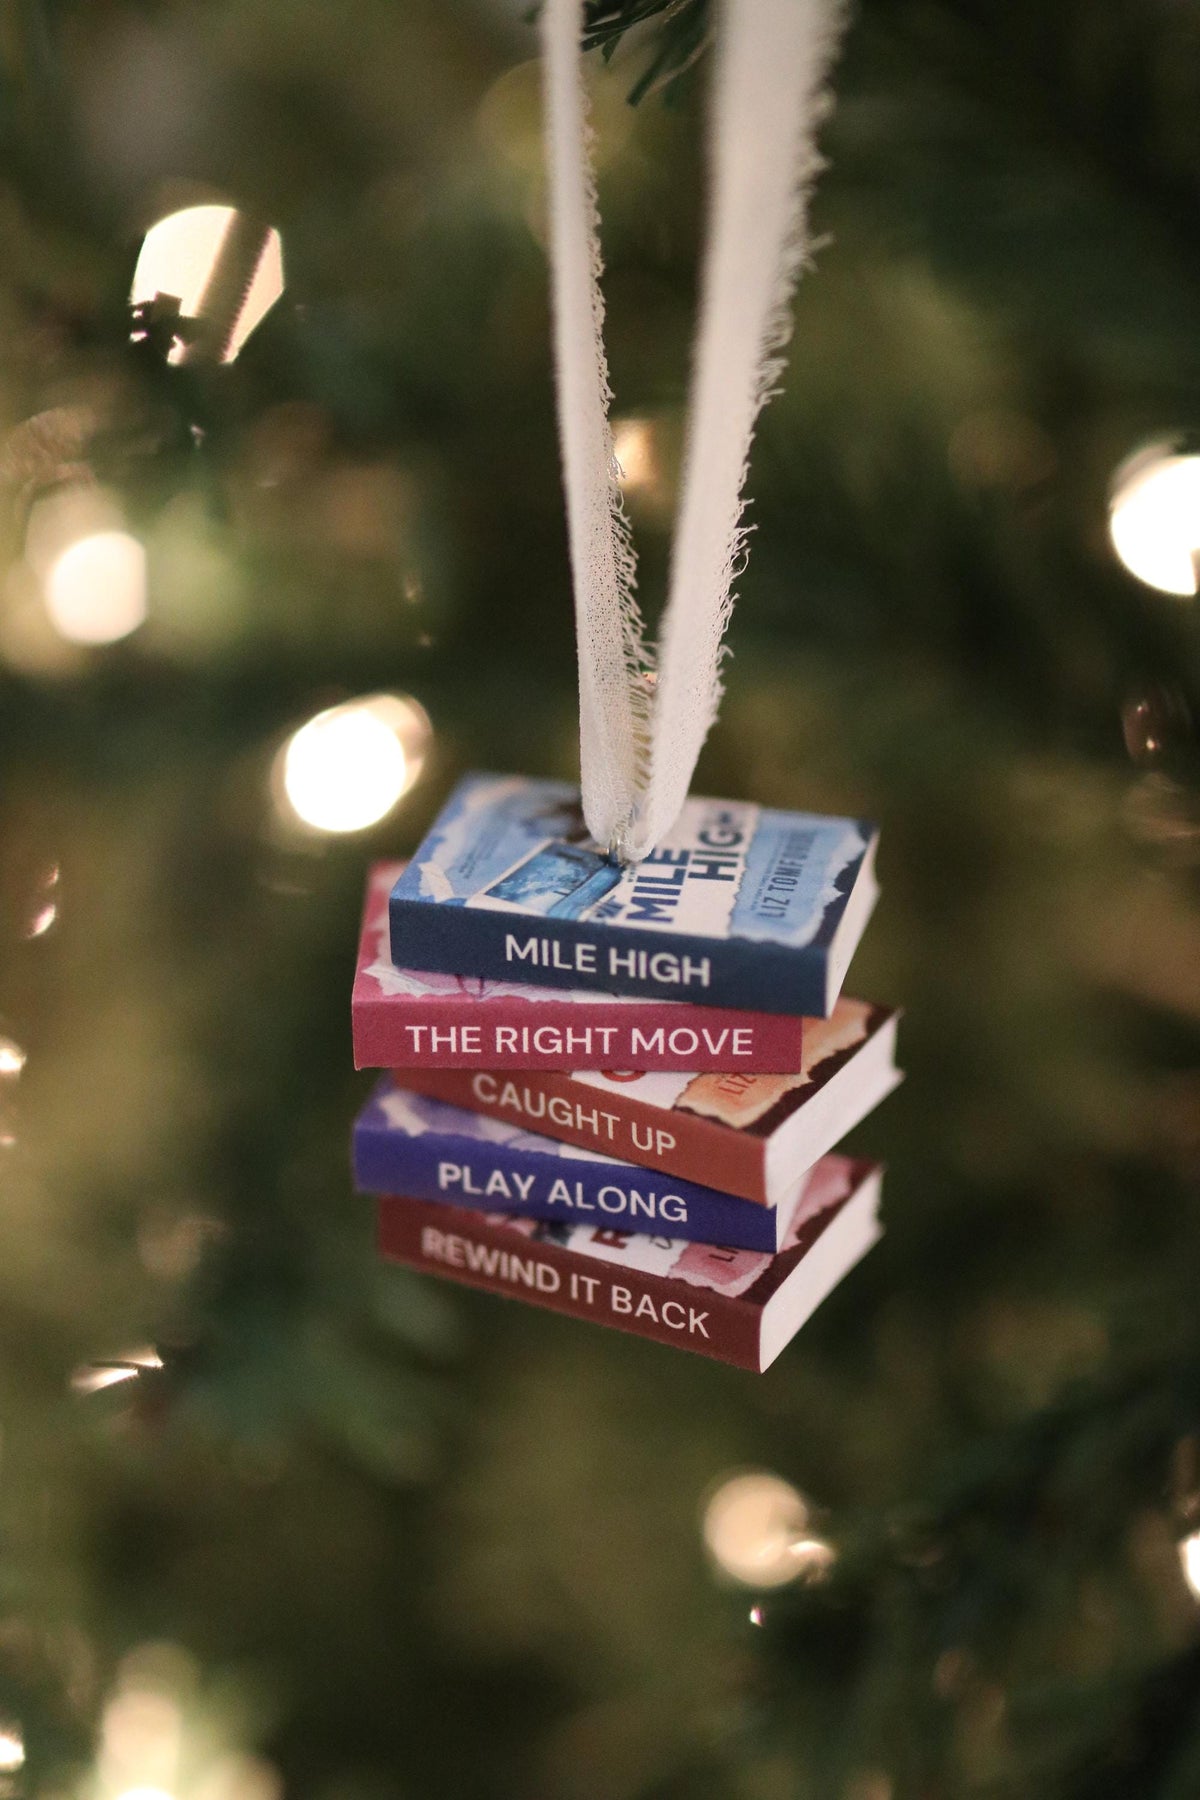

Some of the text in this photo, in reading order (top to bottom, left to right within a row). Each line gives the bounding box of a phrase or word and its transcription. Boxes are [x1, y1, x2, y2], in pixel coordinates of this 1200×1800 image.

[504, 934, 710, 987] MILE HIGH
[405, 1026, 753, 1055] THE RIGHT MOVE
[472, 1073, 676, 1155] CAUGHT UP
[438, 1162, 688, 1222] PLAY ALONG
[421, 1226, 560, 1293] REWIND
[570, 1273, 600, 1304] IT
[611, 1285, 710, 1338] BACK
